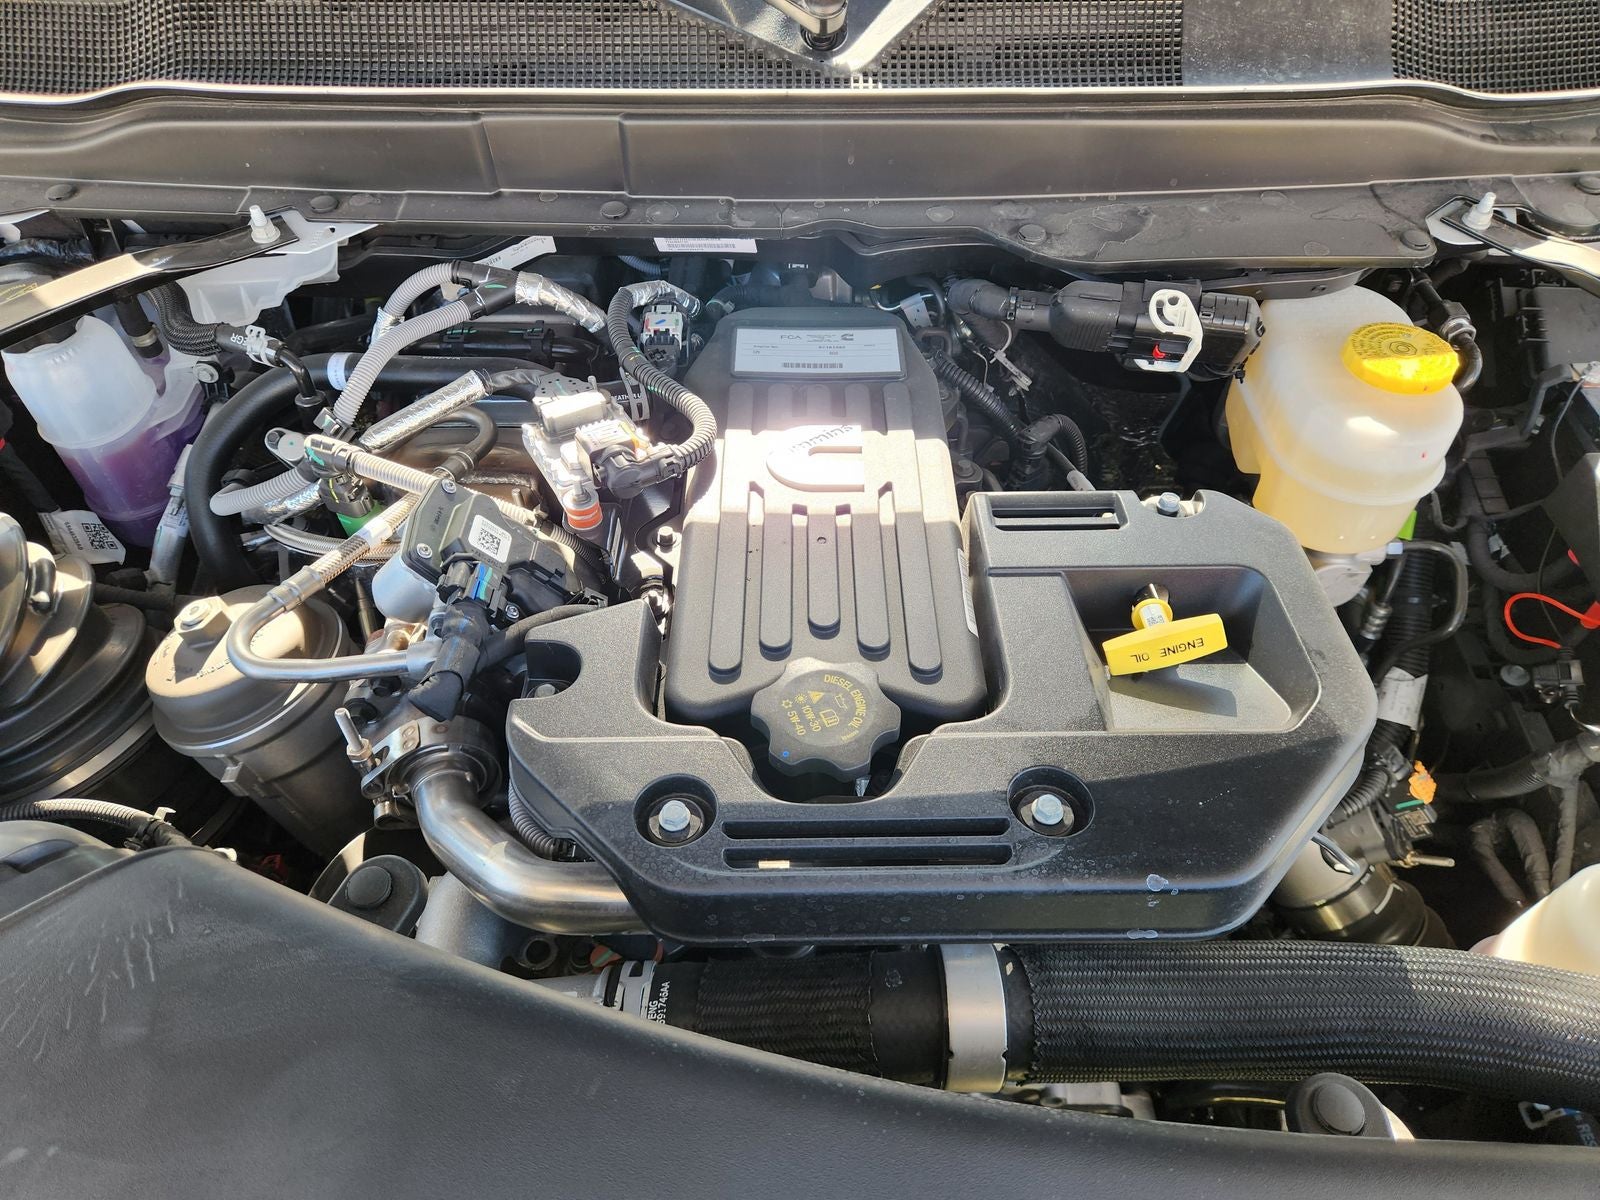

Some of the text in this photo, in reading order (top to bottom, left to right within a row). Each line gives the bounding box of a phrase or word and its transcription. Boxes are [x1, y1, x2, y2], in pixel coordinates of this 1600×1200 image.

[1130, 637, 1205, 663] ENGINE OIL
[824, 674, 853, 692] DIESEL
[851, 689, 867, 717] ENGINE
[787, 710, 806, 736] 5W-40
[801, 704, 822, 732] 10W-30
[848, 718, 864, 729] OIL
[648, 1000, 658, 1020] ENG
